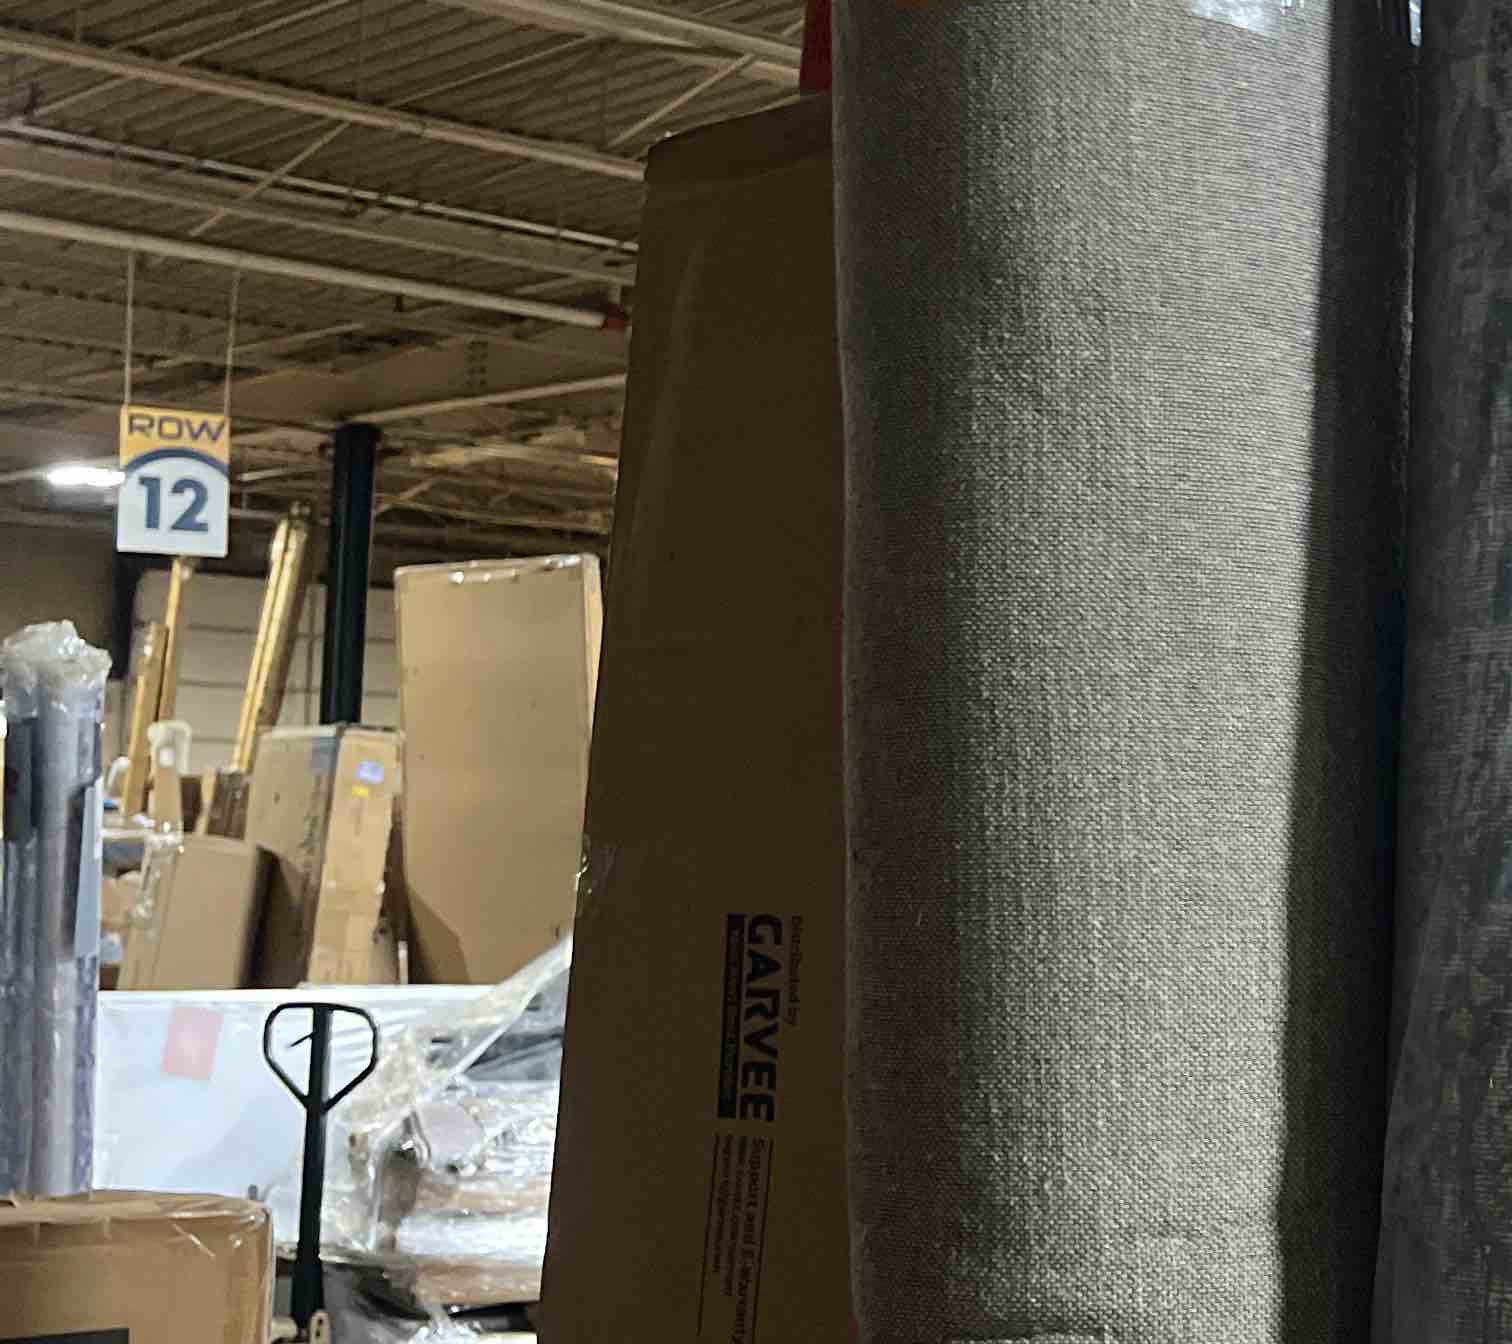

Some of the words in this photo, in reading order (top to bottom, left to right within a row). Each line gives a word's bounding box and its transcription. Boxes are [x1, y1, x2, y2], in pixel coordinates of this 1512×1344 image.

[128, 413, 225, 441] ROW
[138, 476, 209, 532] 12
[739, 913, 784, 1124] GARVEE
